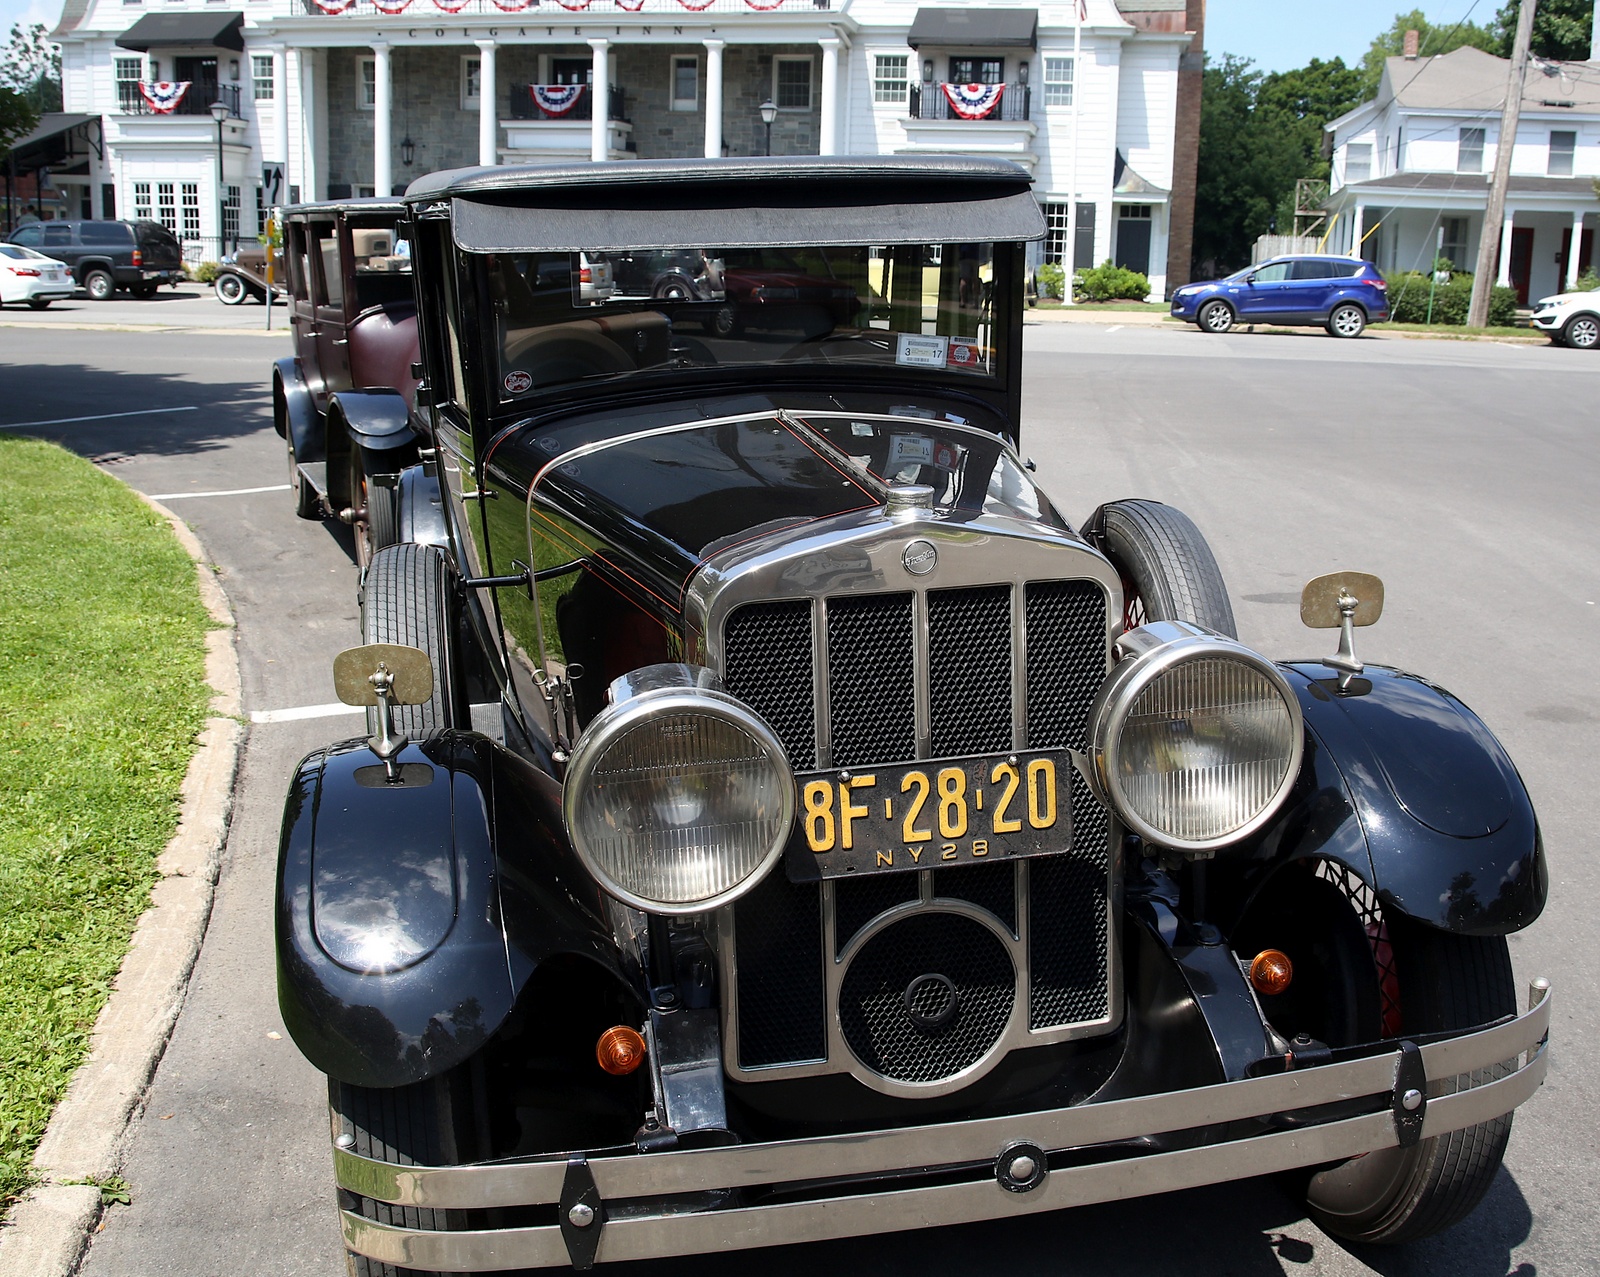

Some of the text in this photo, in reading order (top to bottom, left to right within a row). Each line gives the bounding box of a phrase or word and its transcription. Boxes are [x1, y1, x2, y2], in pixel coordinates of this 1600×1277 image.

[408, 25, 684, 38] COLGATE INN
[932, 349, 943, 359] 17
